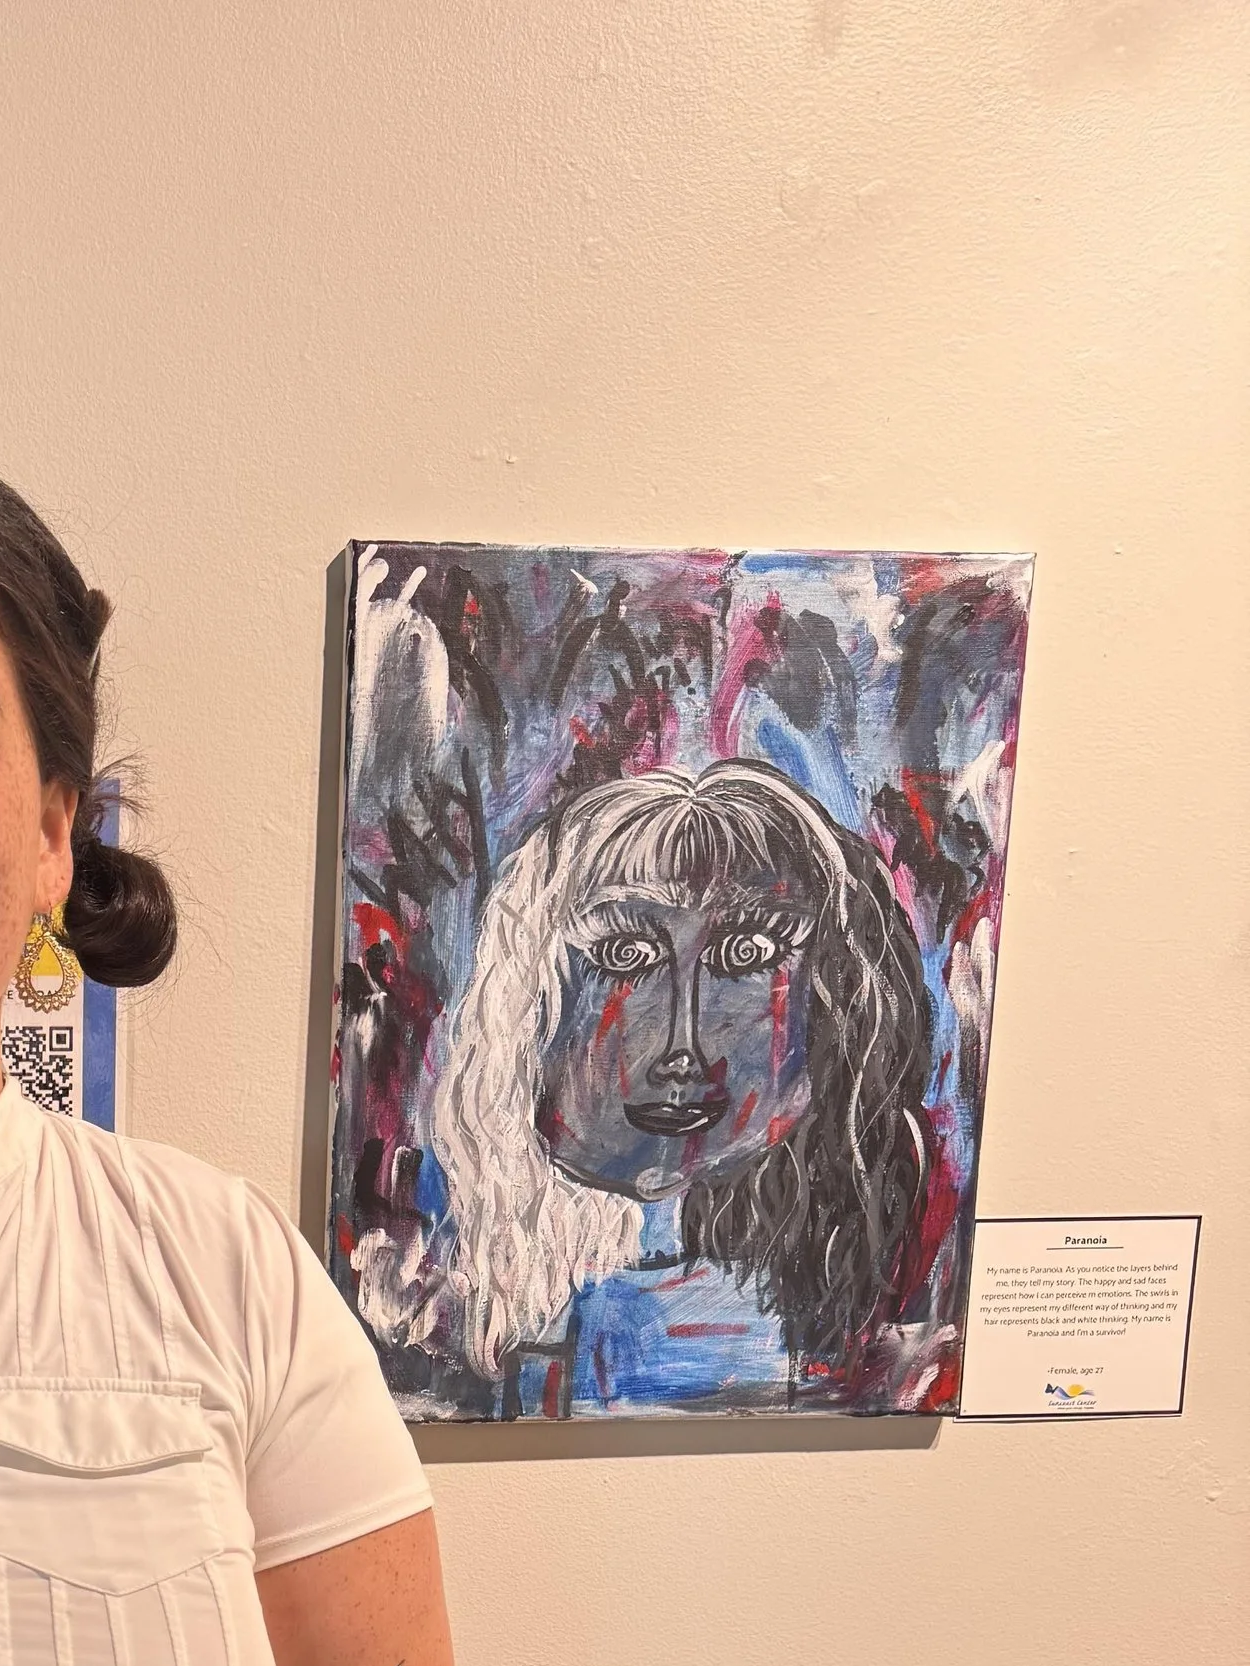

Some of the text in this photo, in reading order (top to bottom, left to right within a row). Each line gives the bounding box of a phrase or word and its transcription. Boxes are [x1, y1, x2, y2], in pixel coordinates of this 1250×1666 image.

[1065, 1236, 1108, 1245] Paranoia
[987, 1267, 998, 1277] My
[1092, 1265, 1115, 1273] notice
[1130, 1265, 1151, 1273] layers
[1011, 1280, 1028, 1288] they
[1043, 1280, 1055, 1288] my
[1056, 1279, 1076, 1288] story.
[1078, 1278, 1093, 1286] The
[1094, 1278, 1117, 1287] happy
[1133, 1277, 1146, 1285] sad
[1148, 1277, 1167, 1285] faces
[981, 1293, 1017, 1301] represent
[1056, 1291, 1087, 1300] perceive
[1135, 1289, 1148, 1297] The
[1150, 1289, 1170, 1297] swirls
[993, 1306, 1011, 1314] eyes
[1012, 1305, 1047, 1313] represent
[1049, 1305, 1061, 1313] my
[1062, 1304, 1093, 1312] different
[1095, 1304, 1109, 1312] way
[1120, 1303, 1150, 1311] thinking
[1166, 1303, 1177, 1311] my
[1000, 1318, 1039, 1326] represents
[1131, 1316, 1142, 1324] My
[1080, 1368, 1094, 1376] age
